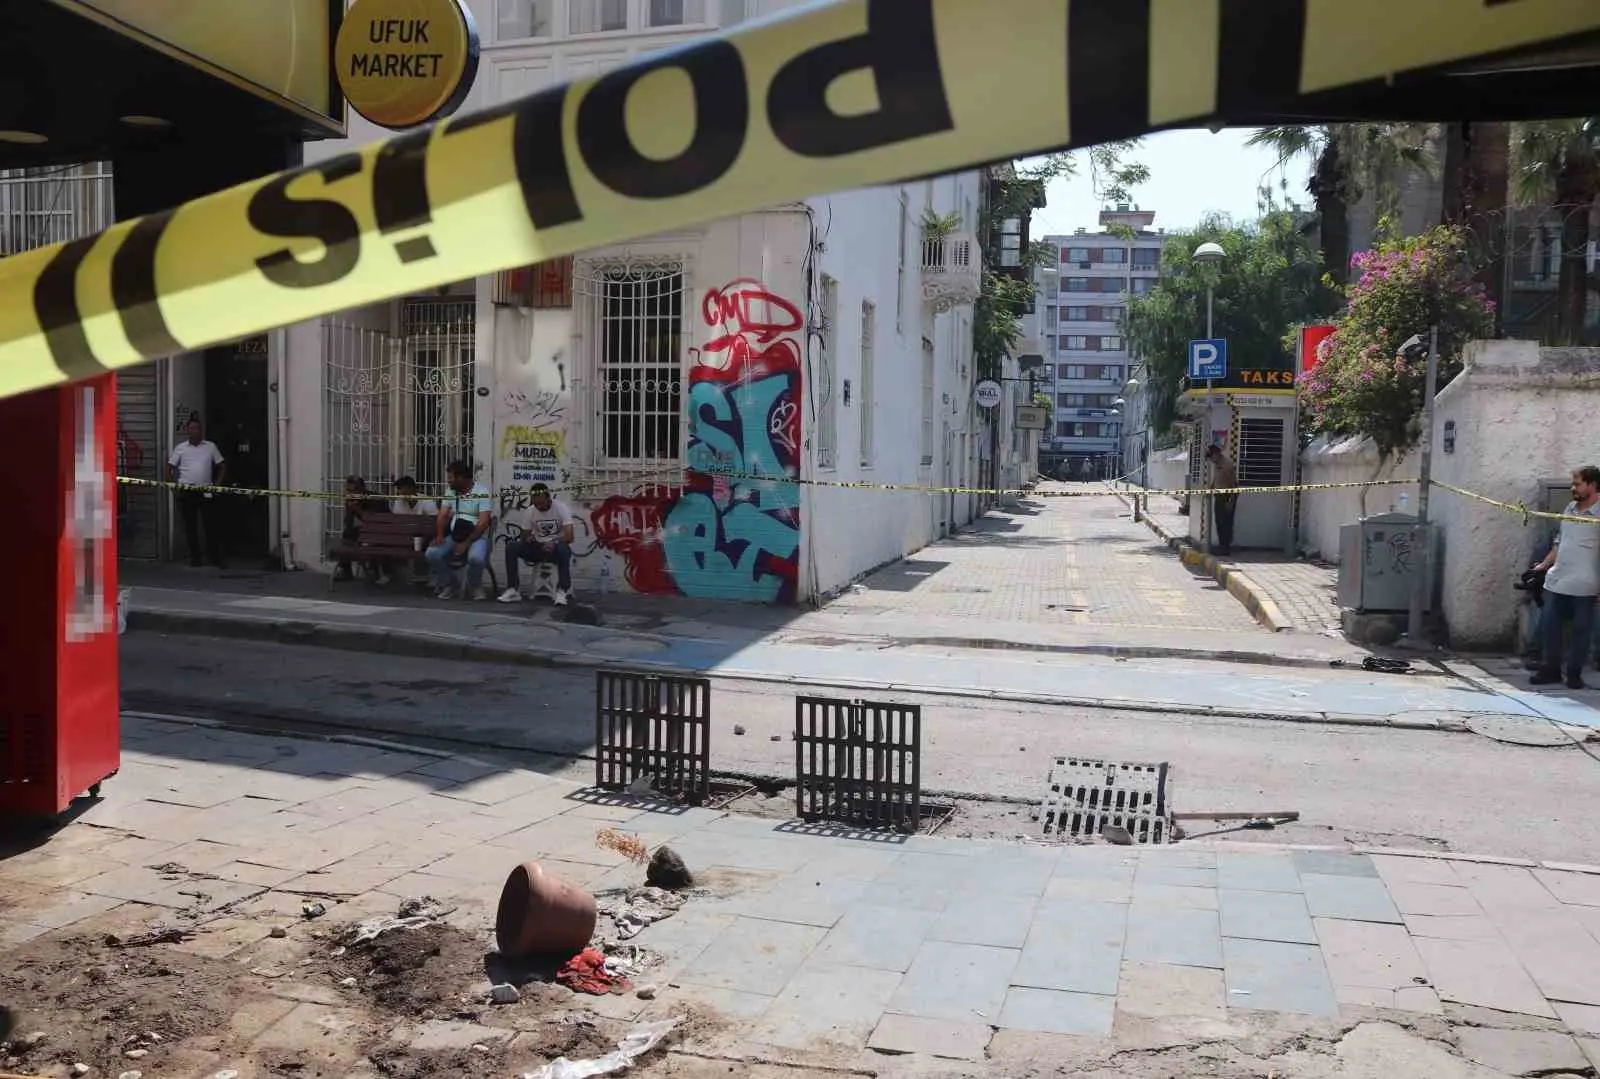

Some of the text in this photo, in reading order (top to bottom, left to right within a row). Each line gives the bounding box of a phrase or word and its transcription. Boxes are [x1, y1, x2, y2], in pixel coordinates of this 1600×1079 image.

[370, 20, 430, 43] UFUK
[350, 54, 443, 78] MARKET
[1193, 343, 1218, 376] P
[1240, 371, 1294, 384] TAKS
[514, 446, 557, 459] MURDA
